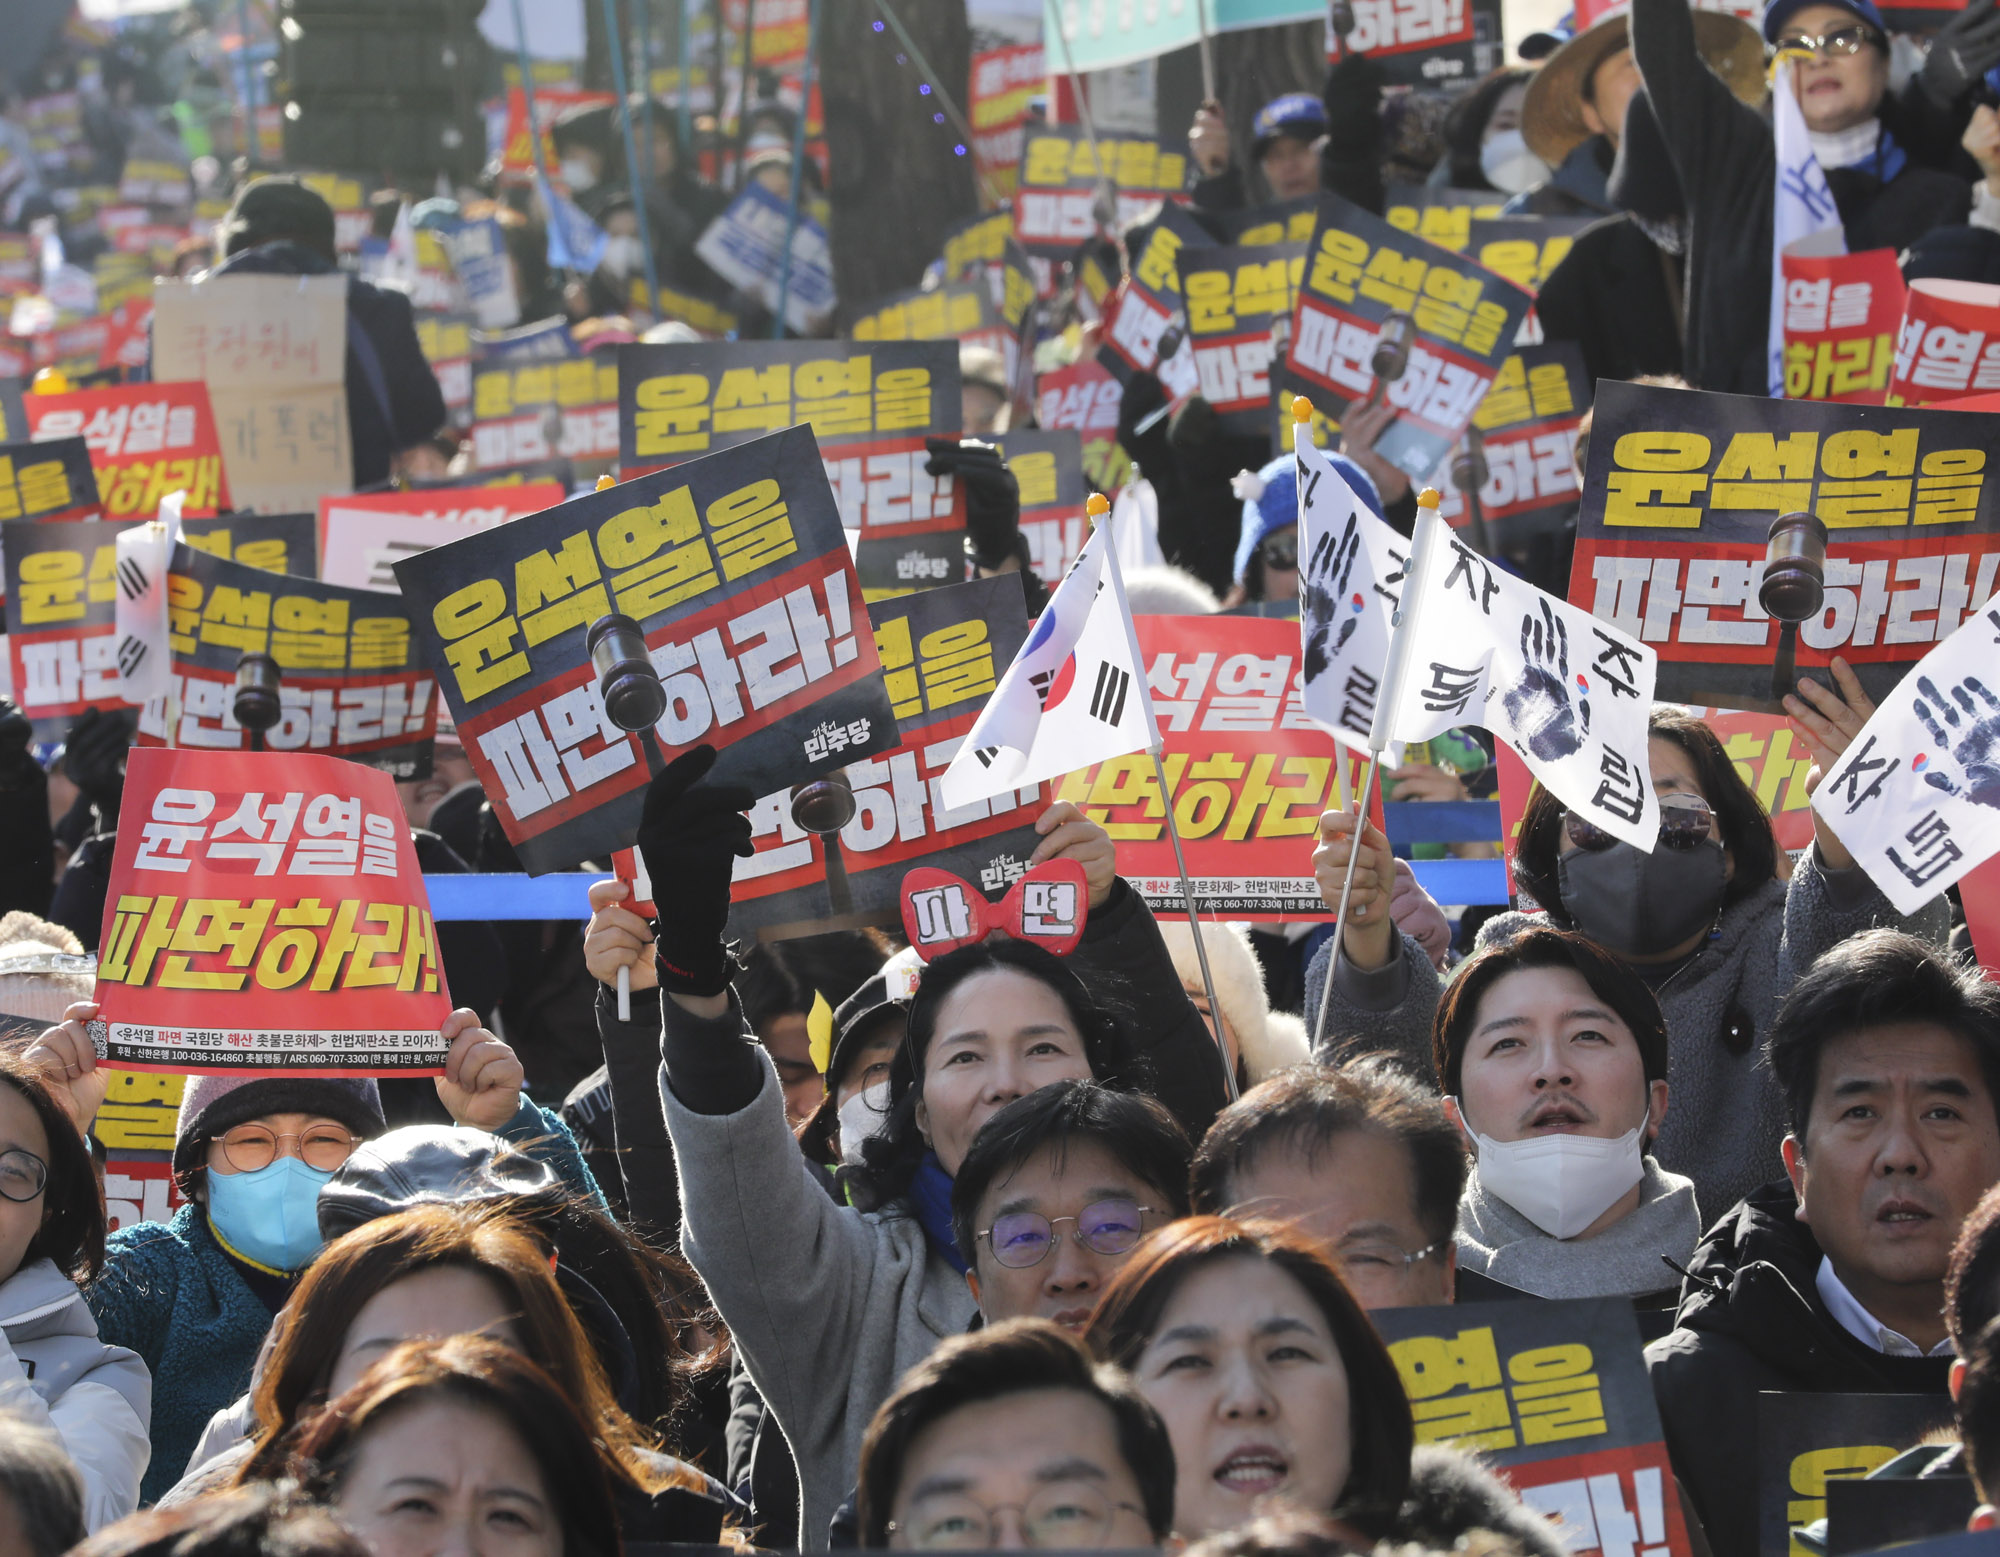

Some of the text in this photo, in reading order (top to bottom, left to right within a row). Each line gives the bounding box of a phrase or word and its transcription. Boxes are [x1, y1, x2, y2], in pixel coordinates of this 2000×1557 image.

[1309, 227, 1508, 357] 윤석열을
[635, 355, 931, 457] 윤석열을
[1603, 428, 1987, 528] 윤석열을
[432, 478, 798, 703] 윤석열을
[803, 717, 871, 763] 민주당
[811, 720, 837, 737] 더불어
[133, 787, 398, 878] 윤석열을
[911, 883, 1077, 944] 파 면
[1145, 880, 1170, 894] 해산
[1244, 880, 1316, 894] 헌법재판소로
[1204, 899, 1222, 909] ARS
[1224, 899, 1282, 910] 060-707-3300
[97, 894, 439, 993] 파면하라!
[116, 1027, 438, 1048] <윤석열 파면 국힘당 해산 촛불문화제> 헌법재판소로 모이자!
[116, 1046, 132, 1057] 후원
[137, 1048, 169, 1060] 신한은행
[171, 1050, 244, 1063] 100-036-164860
[245, 1053, 282, 1064] 촛불행동
[289, 1054, 308, 1064] ARS
[310, 1054, 369, 1064] 060-707-3300
[370, 1053, 382, 1065] (한
[383, 1053, 398, 1065] 통에
[400, 1054, 412, 1064] 1만
[424, 1054, 439, 1064] 여러
